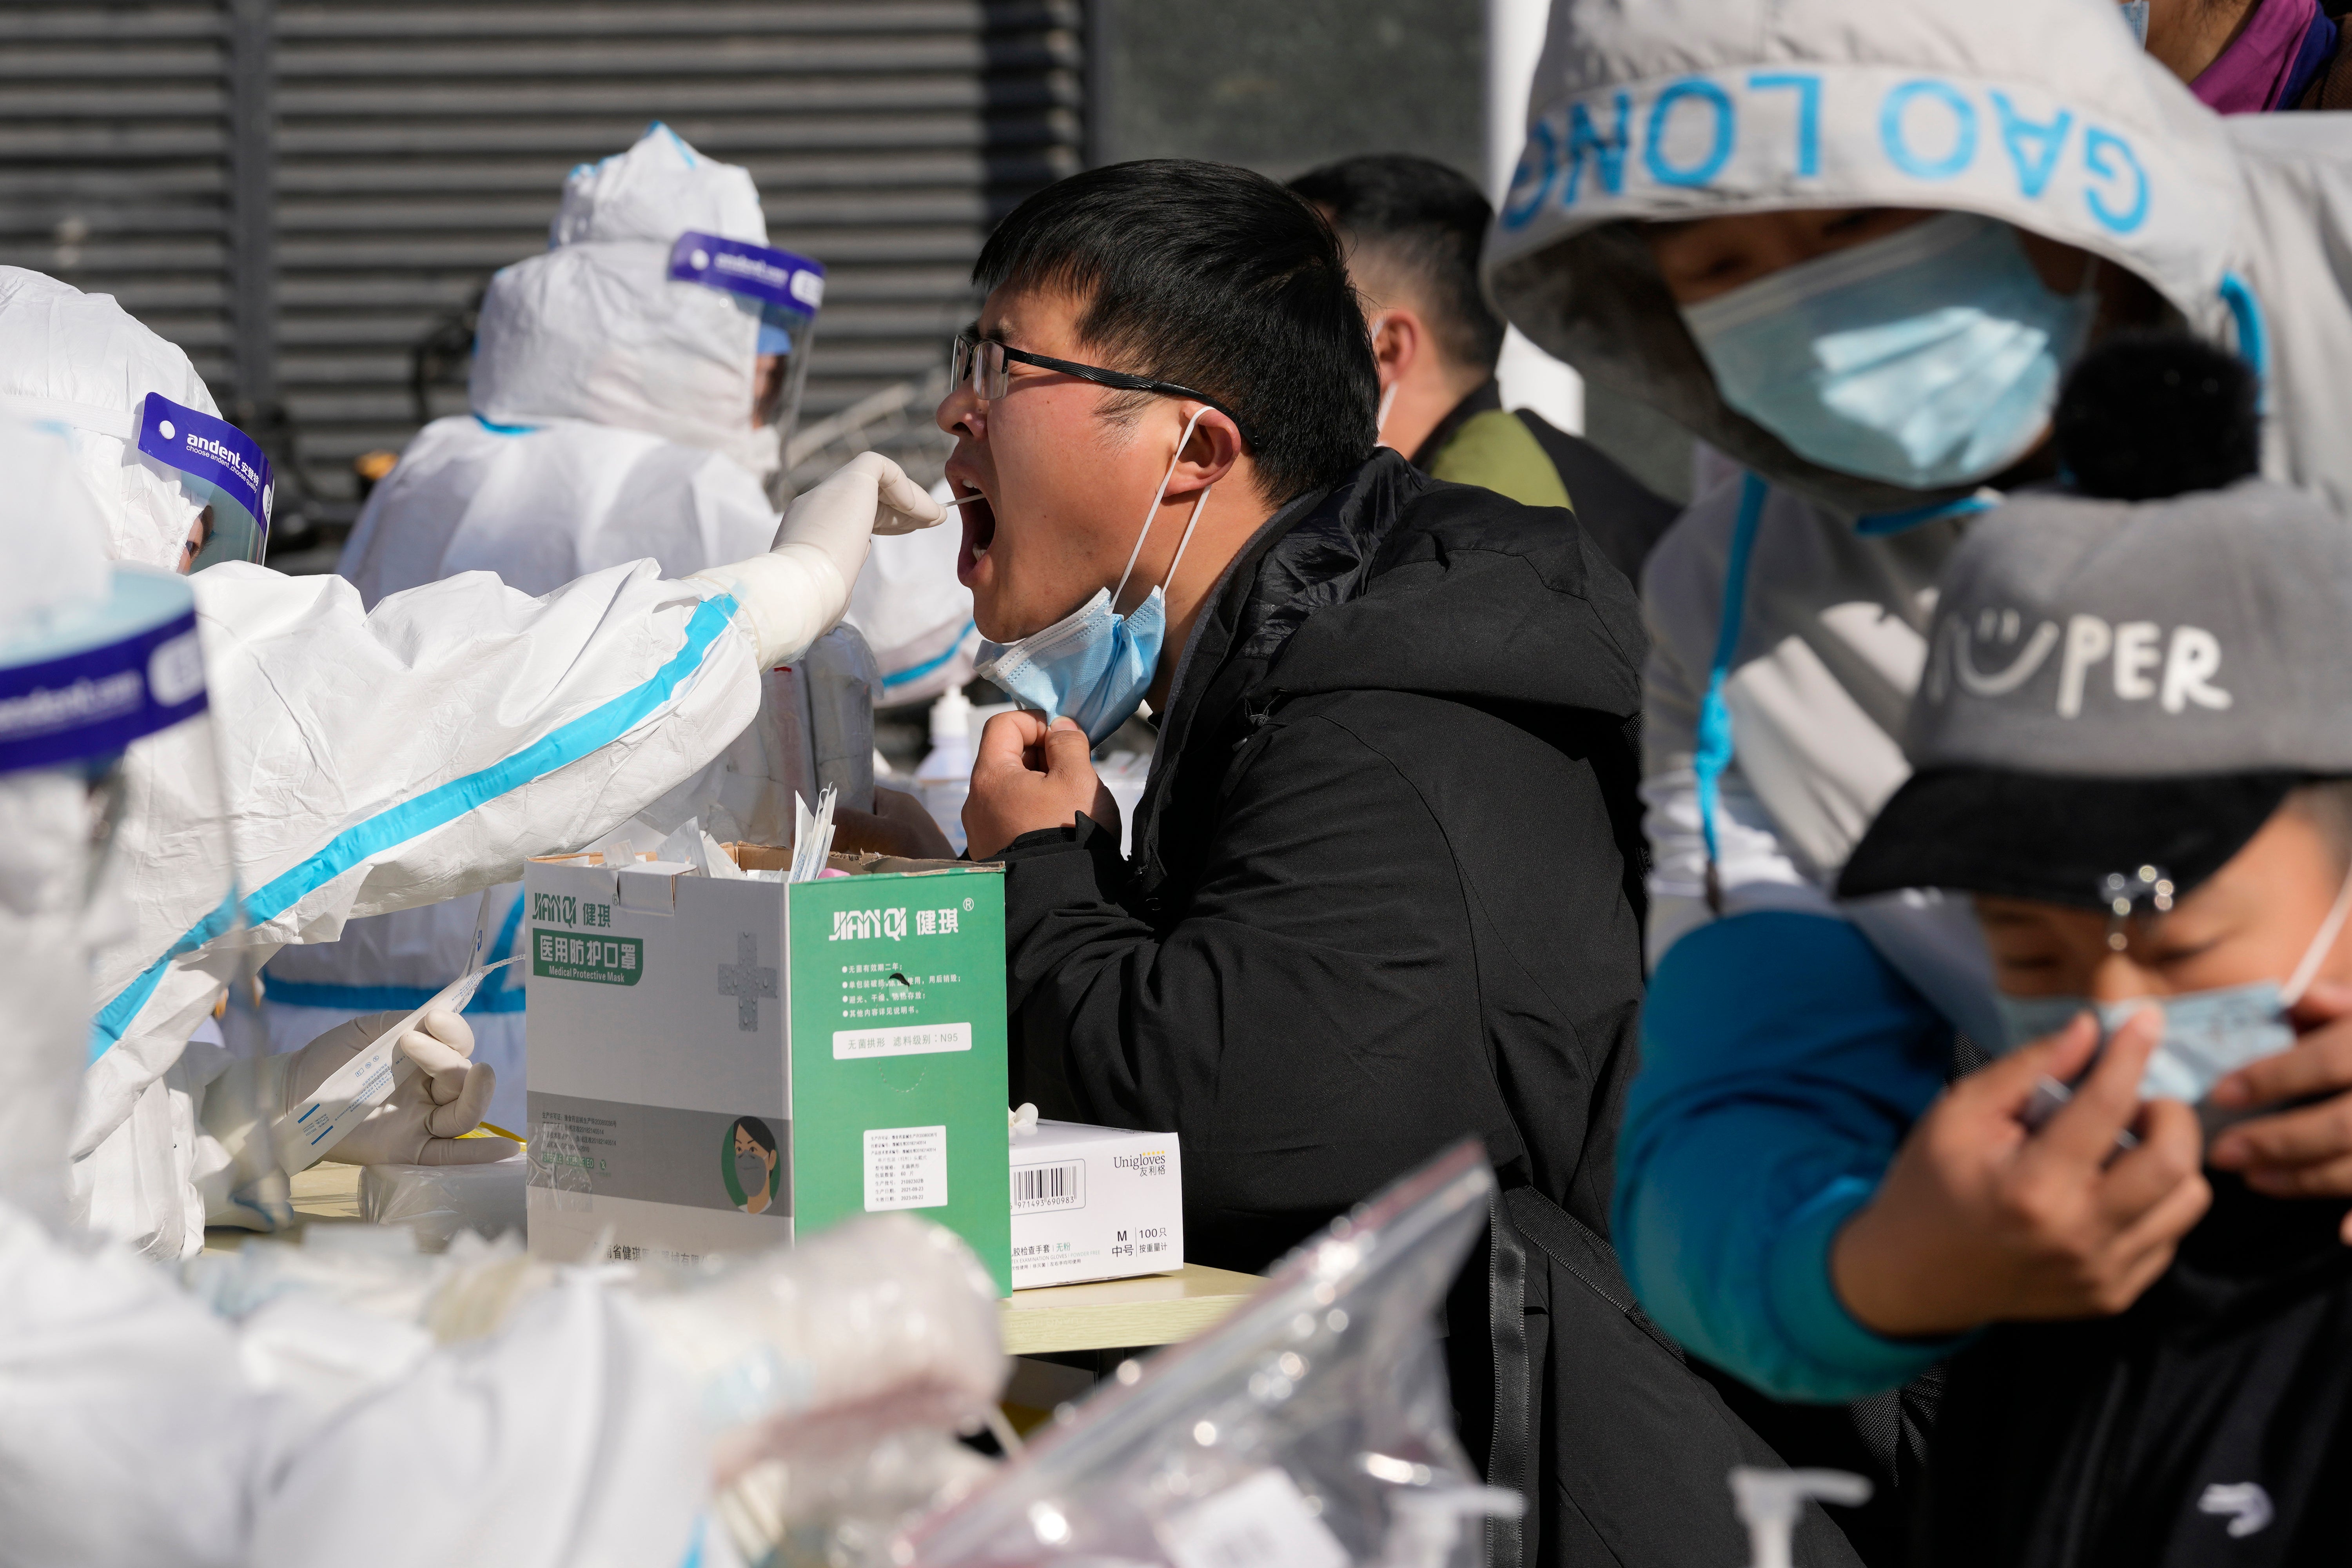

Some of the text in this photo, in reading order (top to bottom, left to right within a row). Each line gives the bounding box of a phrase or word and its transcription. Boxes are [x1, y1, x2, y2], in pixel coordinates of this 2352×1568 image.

[187, 433, 241, 469] andent
[186, 445, 210, 457] choose
[210, 454, 230, 468] andent
[246, 478, 258, 494] quality
[241, 461, 260, 486] 安登特
[583, 903, 611, 927] 健琪
[916, 908, 959, 936] 健琪
[540, 935, 636, 969] 医用防护口罩
[549, 965, 624, 982] Medical Protective Mask
[848, 1037, 885, 1050] 无菌拱形
[1113, 1154, 1166, 1170] Unigloves
[1140, 1164, 1166, 1177] 友利格
[1018, 1199, 1044, 1209] 971493
[1047, 1196, 1074, 1205] 690983
[1117, 1230, 1127, 1242] M
[1011, 1242, 1071, 1257] 胶检查手套 无粉
[1112, 1244, 1134, 1258] 中号
[1140, 1242, 1167, 1253] 按重量计
